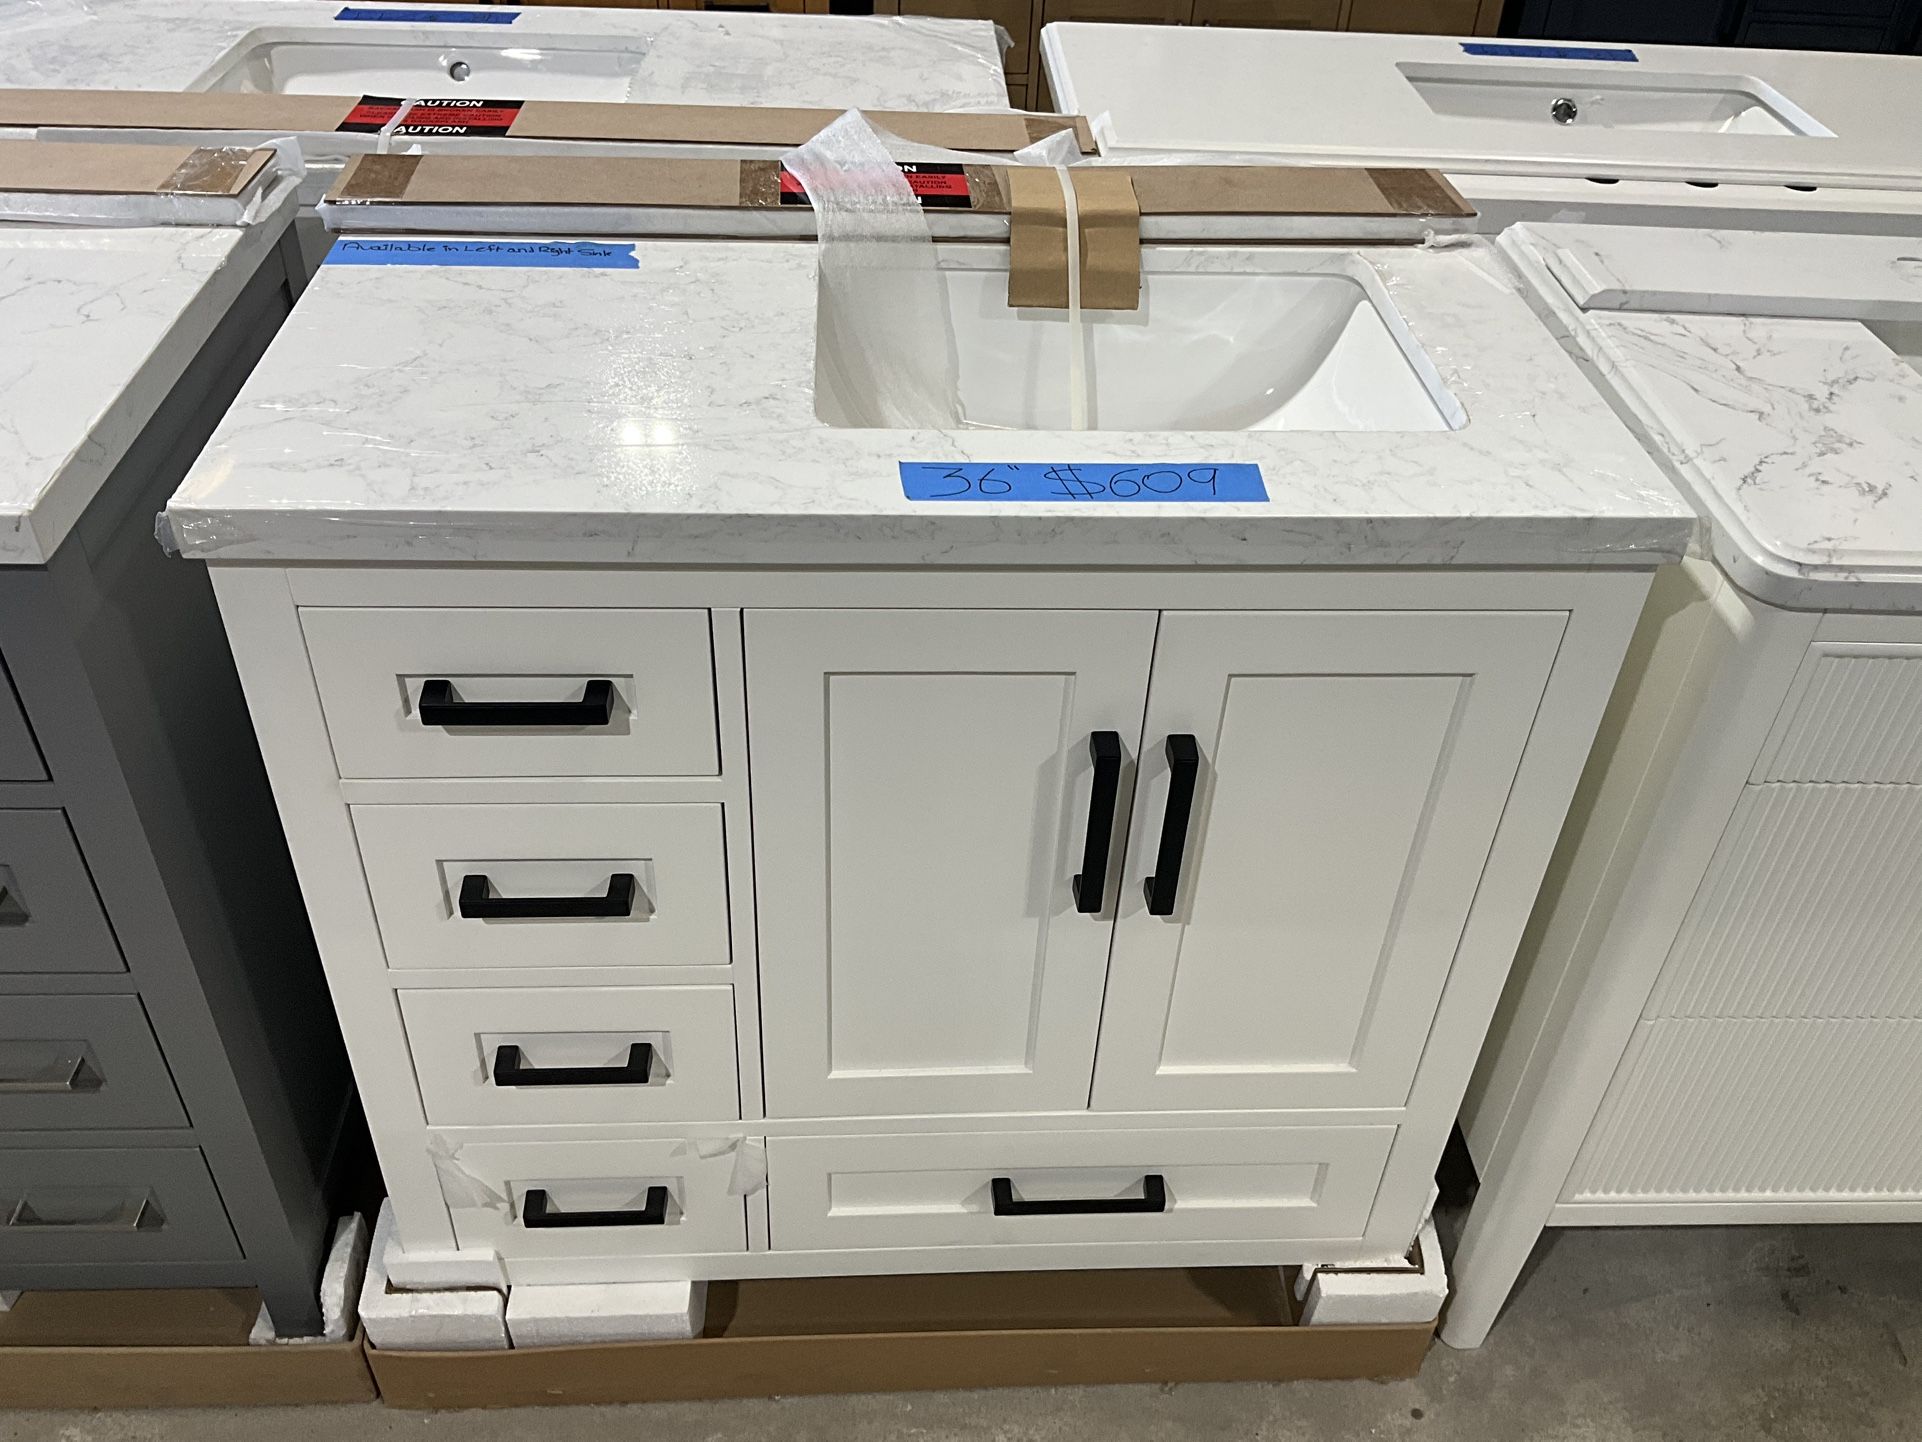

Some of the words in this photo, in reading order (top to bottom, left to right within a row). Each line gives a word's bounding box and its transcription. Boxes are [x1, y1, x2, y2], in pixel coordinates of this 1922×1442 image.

[342, 242, 436, 252] Available
[463, 244, 504, 253] Left
[921, 464, 1021, 498] 36"
[1043, 463, 1220, 500] $609
